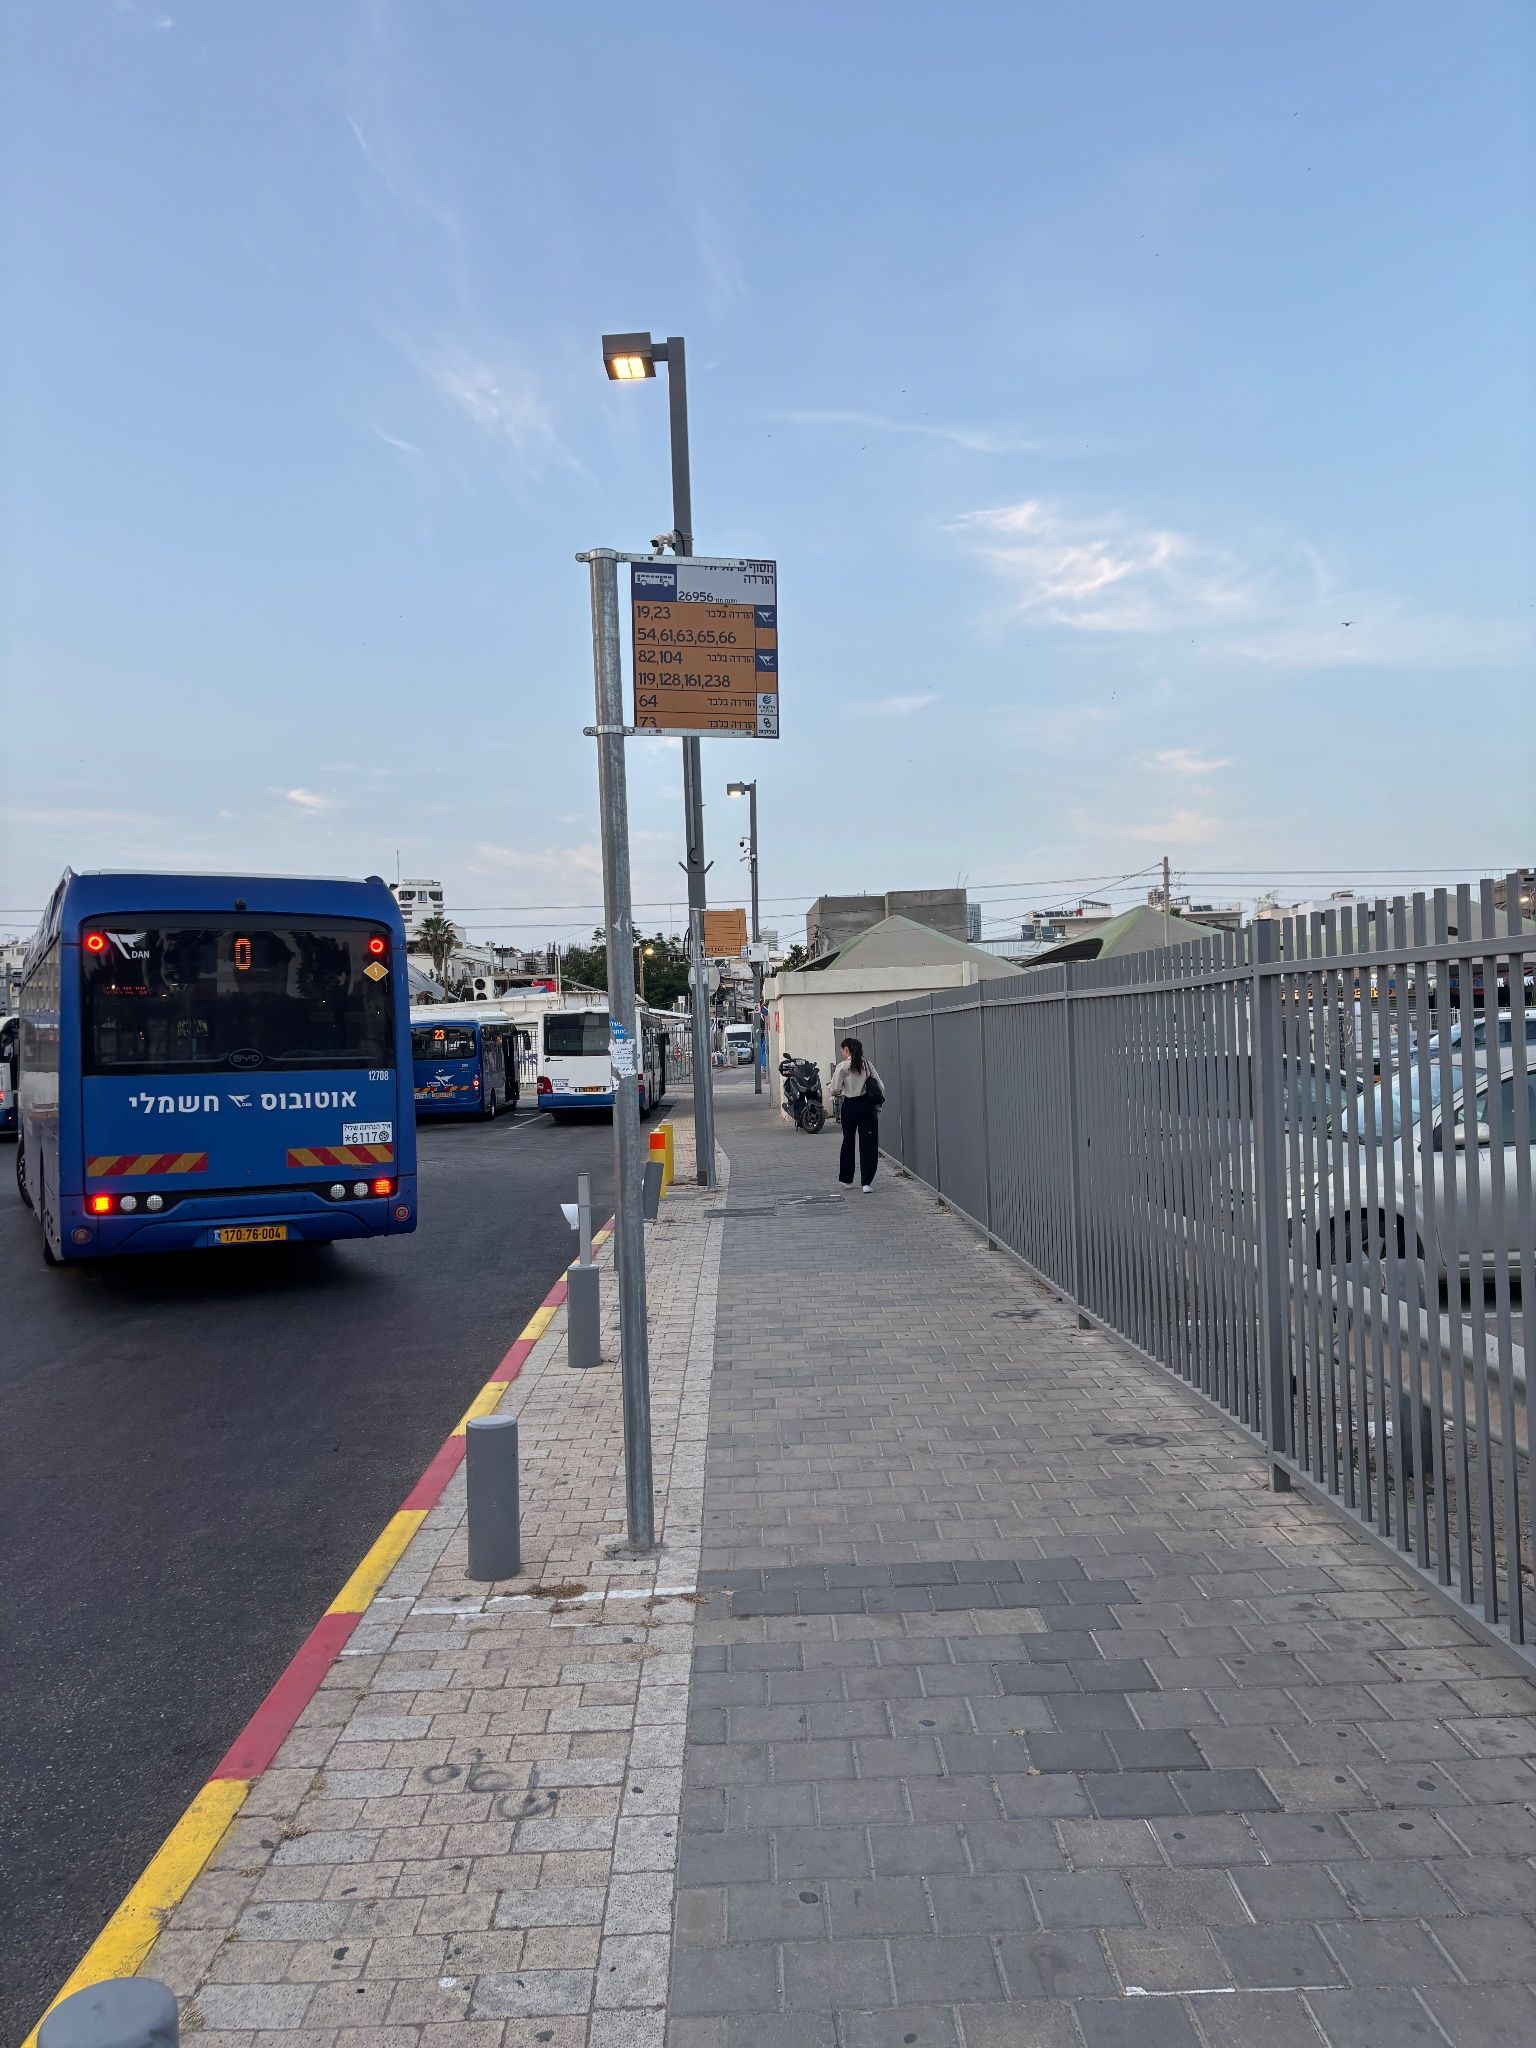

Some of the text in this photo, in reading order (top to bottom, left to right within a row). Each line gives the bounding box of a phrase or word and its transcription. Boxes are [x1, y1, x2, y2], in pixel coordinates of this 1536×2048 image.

[749, 563, 774, 574] מסוף
[744, 575, 774, 585] הורדה
[678, 591, 714, 602] 26956
[637, 606, 671, 621] 19,23
[706, 609, 754, 620] הורדה בלבד
[637, 627, 737, 646] 54,61,63,65,66
[638, 650, 683, 666] 82,104
[707, 653, 755, 664] הורדה בלבד
[638, 672, 731, 690] 119,128,161,238
[639, 694, 658, 708] 64
[708, 697, 755, 708] הורדה בלבד
[640, 716, 657, 728] 73
[708, 719, 756, 729] הורדה בלבד
[131, 950, 150, 959] DAN
[235, 938, 251, 970] 0
[434, 1029, 445, 1040] 23
[233, 1054, 260, 1062] BYD
[368, 1071, 389, 1081] 12708
[128, 1091, 357, 1114] אוטובוס חשמלי
